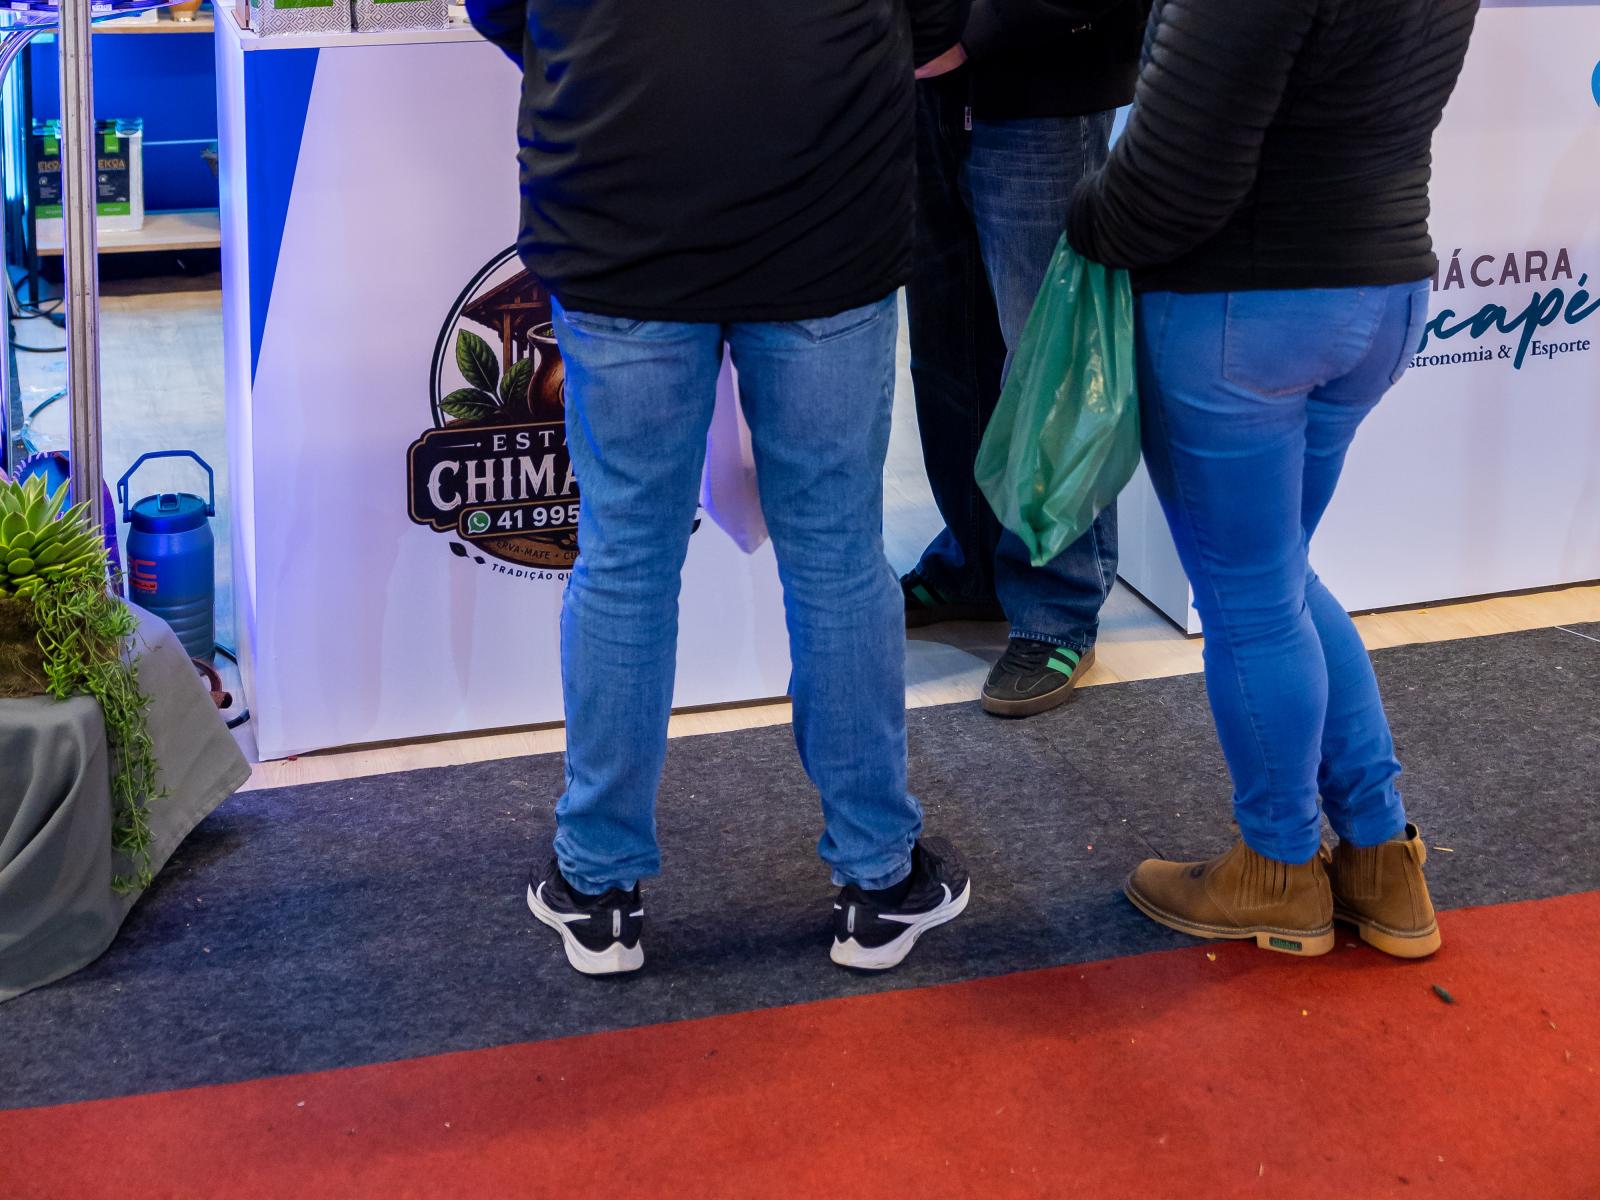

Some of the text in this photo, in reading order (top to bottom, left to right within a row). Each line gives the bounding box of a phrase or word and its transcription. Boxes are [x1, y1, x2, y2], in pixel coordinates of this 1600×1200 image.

[1498, 344, 1512, 359] &
[1531, 340, 1591, 360] Esporte
[493, 430, 567, 452] EST
[497, 509, 523, 529] 41
[491, 563, 553, 580] TRADIÇÃO
